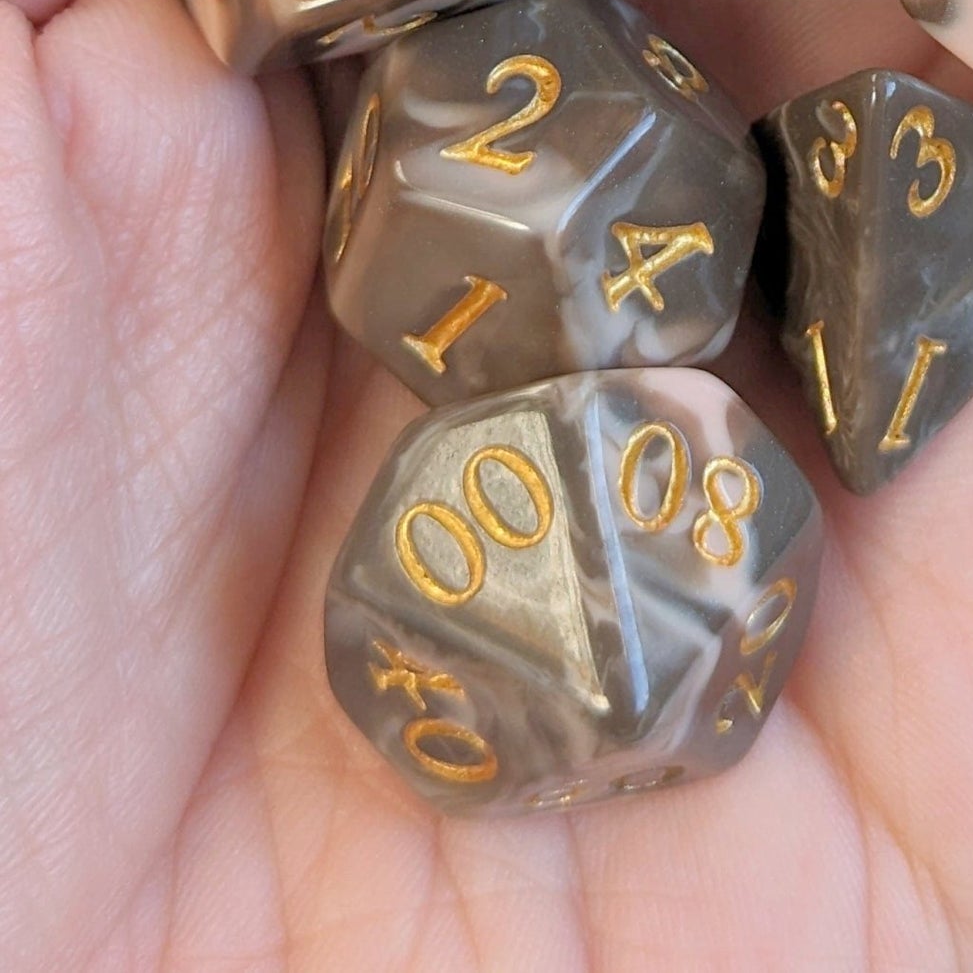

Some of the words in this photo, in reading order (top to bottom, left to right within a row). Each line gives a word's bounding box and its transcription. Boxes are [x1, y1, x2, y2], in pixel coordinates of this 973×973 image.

[439, 54, 562, 176] 2
[889, 104, 957, 219] 3
[402, 274, 509, 377] 1
[602, 221, 715, 313] 4
[878, 334, 948, 454] 1
[394, 445, 554, 606] 00
